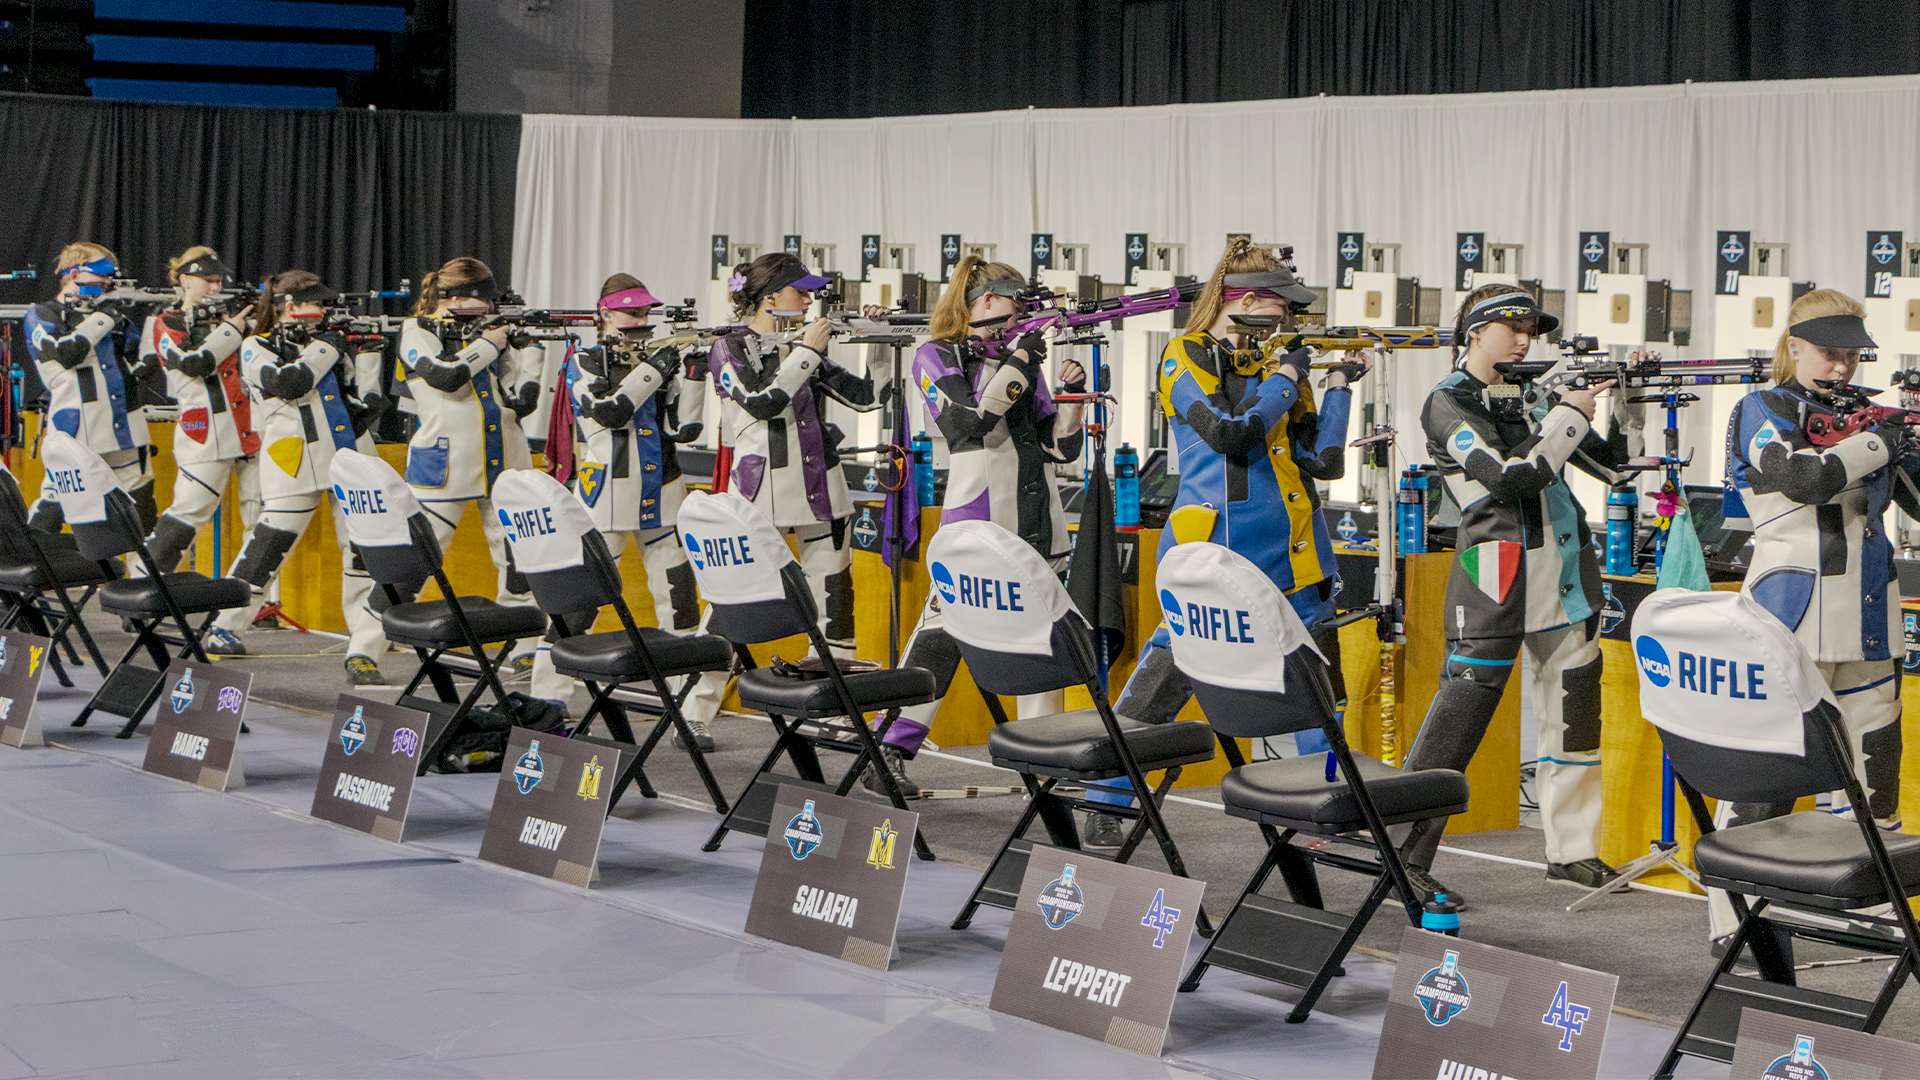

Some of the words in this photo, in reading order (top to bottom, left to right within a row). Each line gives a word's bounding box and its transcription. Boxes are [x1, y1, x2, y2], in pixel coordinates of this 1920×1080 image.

[1343, 267, 1354, 287] 8
[1462, 268, 1474, 289] 9
[1584, 268, 1599, 291] 10
[1723, 270, 1739, 292] 11
[1874, 272, 1892, 295] 12
[55, 469, 86, 494] RIFLE
[348, 489, 387, 514] RIFLE
[513, 506, 556, 539] RIFLE
[703, 535, 754, 567] RIFLE
[959, 574, 1024, 612] RIFLE
[1187, 602, 1254, 643] RIFLE
[1641, 656, 1671, 679] NCAA
[1679, 651, 1767, 700] RIFLE
[217, 686, 243, 714] TCU
[170, 731, 209, 761] HAMES
[391, 727, 419, 758] TCU
[333, 772, 396, 812] PASSMORE
[519, 816, 567, 852] HENRY
[792, 885, 858, 928] SALAFIA
[1039, 894, 1083, 913] CHAMPIONSHIPS
[1042, 956, 1132, 1008] LEPPERT
[1416, 984, 1469, 1006] CHAMPIONSHIPS
